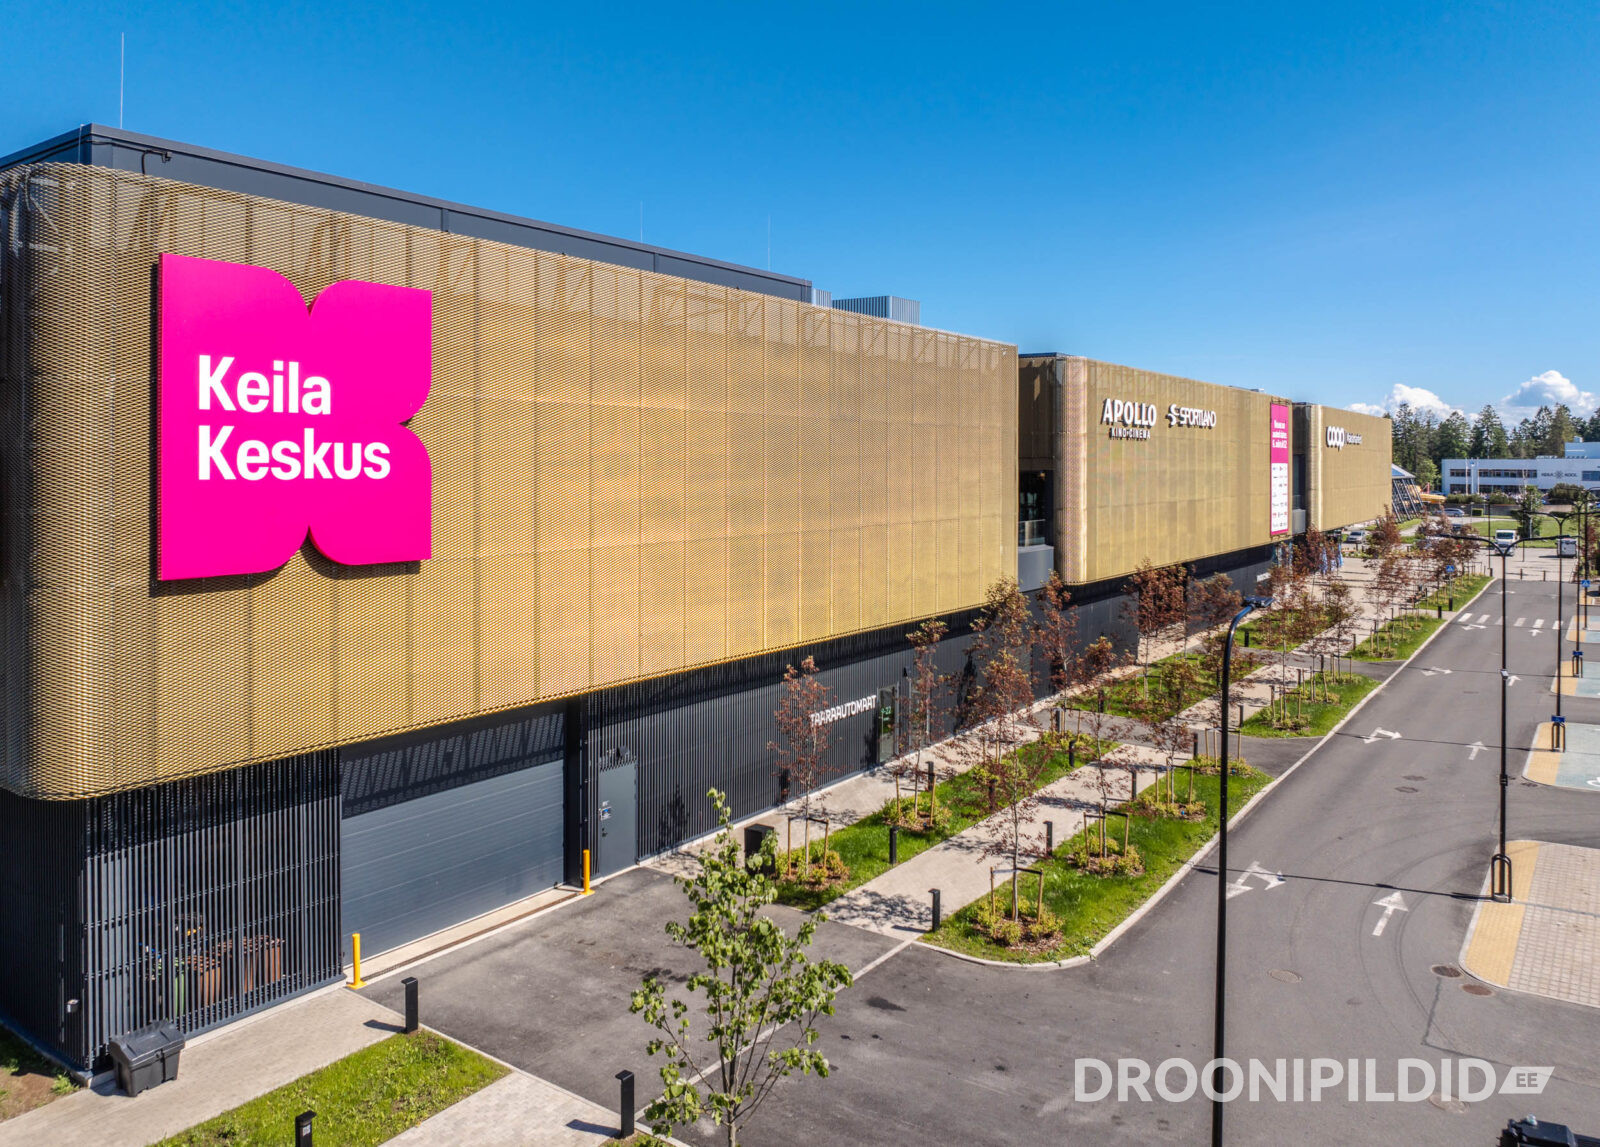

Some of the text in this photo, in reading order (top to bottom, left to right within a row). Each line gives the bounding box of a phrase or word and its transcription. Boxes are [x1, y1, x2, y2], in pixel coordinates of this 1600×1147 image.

[198, 354, 331, 415] Keila
[1103, 398, 1157, 427] APOLLO
[1179, 406, 1217, 428] SPORTLAND
[198, 425, 391, 481] Keskus
[809, 694, 877, 728] TAARAAUTOMAAT
